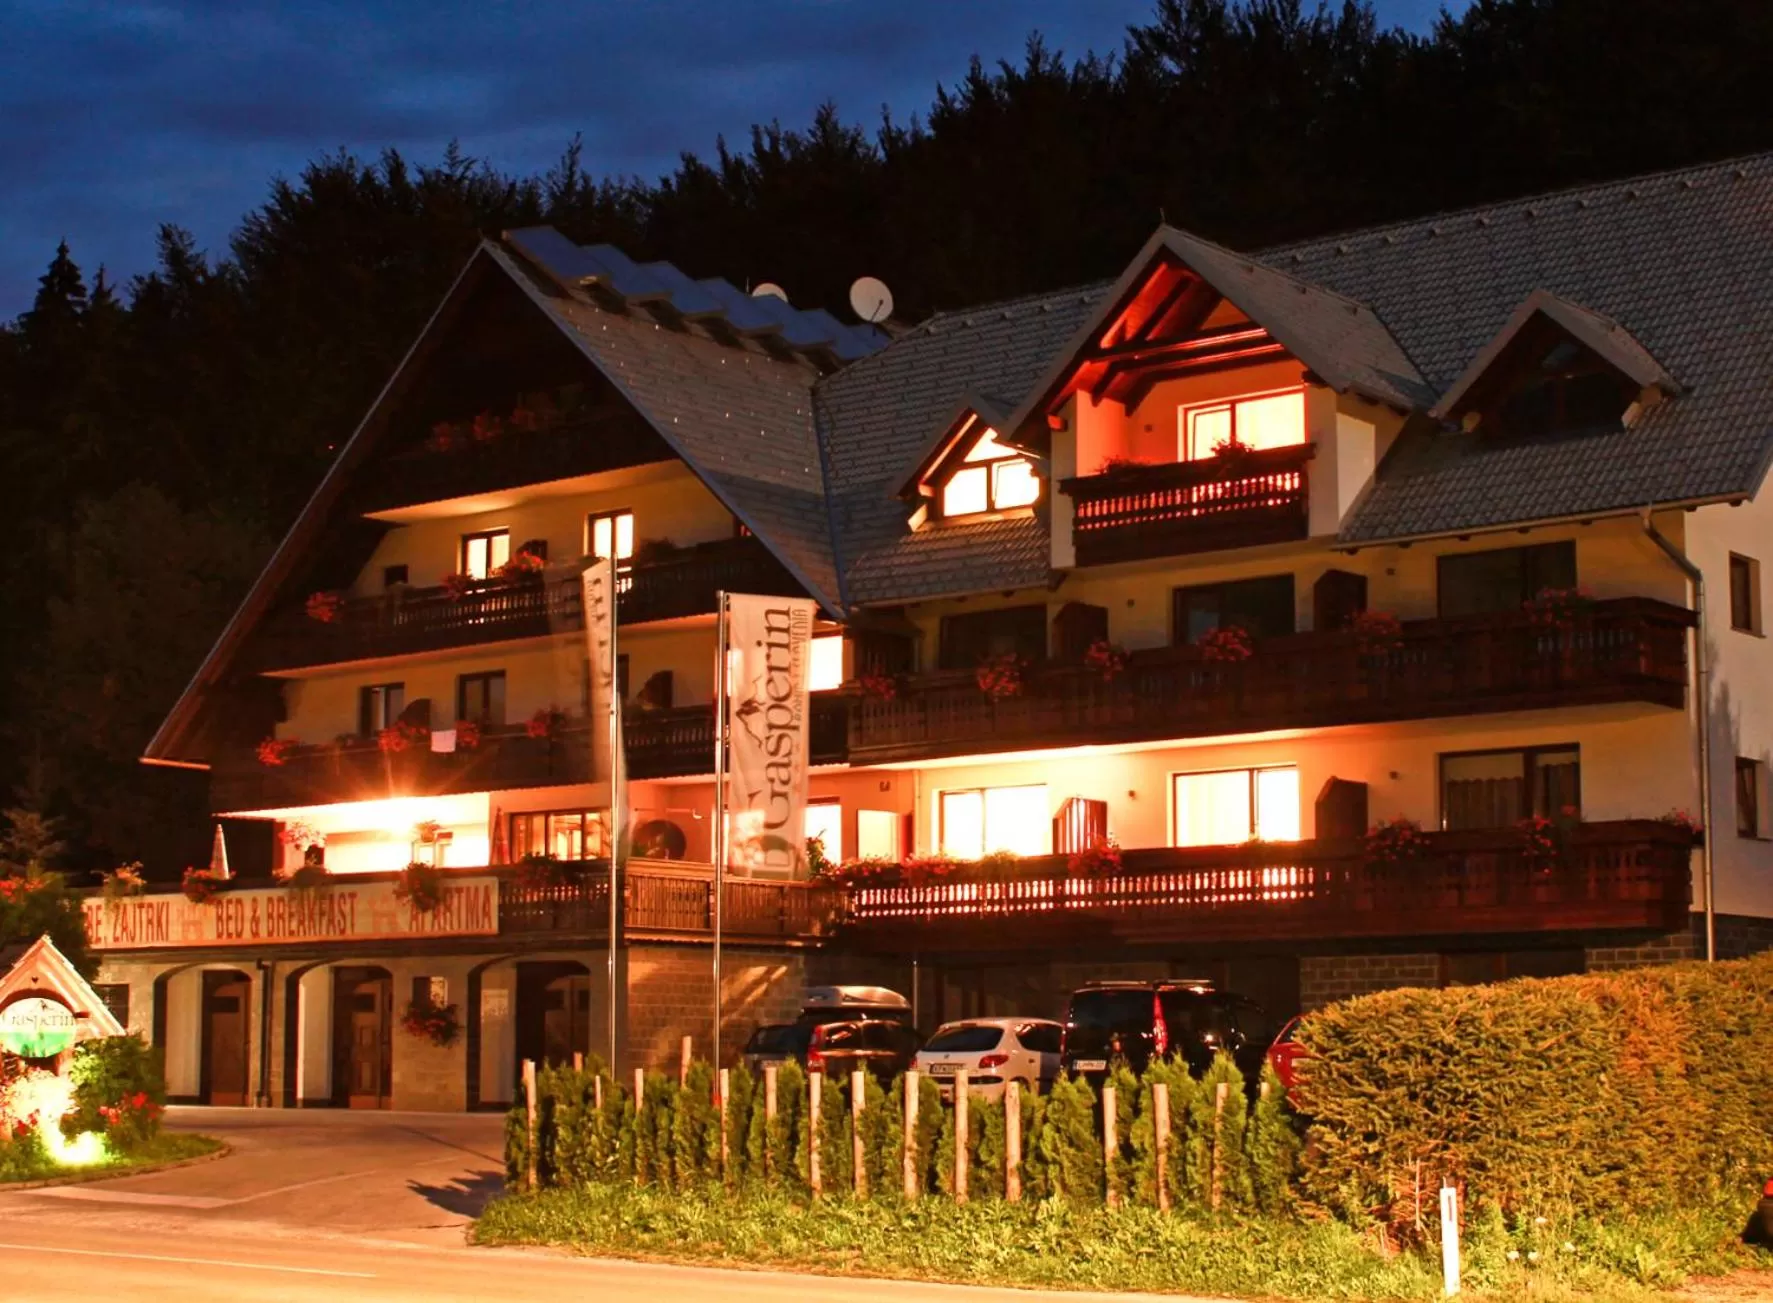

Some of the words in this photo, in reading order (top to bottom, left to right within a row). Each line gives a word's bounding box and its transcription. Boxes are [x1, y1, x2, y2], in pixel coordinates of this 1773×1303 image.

[112, 901, 170, 943] ZAJTRKI
[215, 897, 244, 939] BED
[250, 896, 261, 938] &
[266, 891, 357, 937] BREAKFAST
